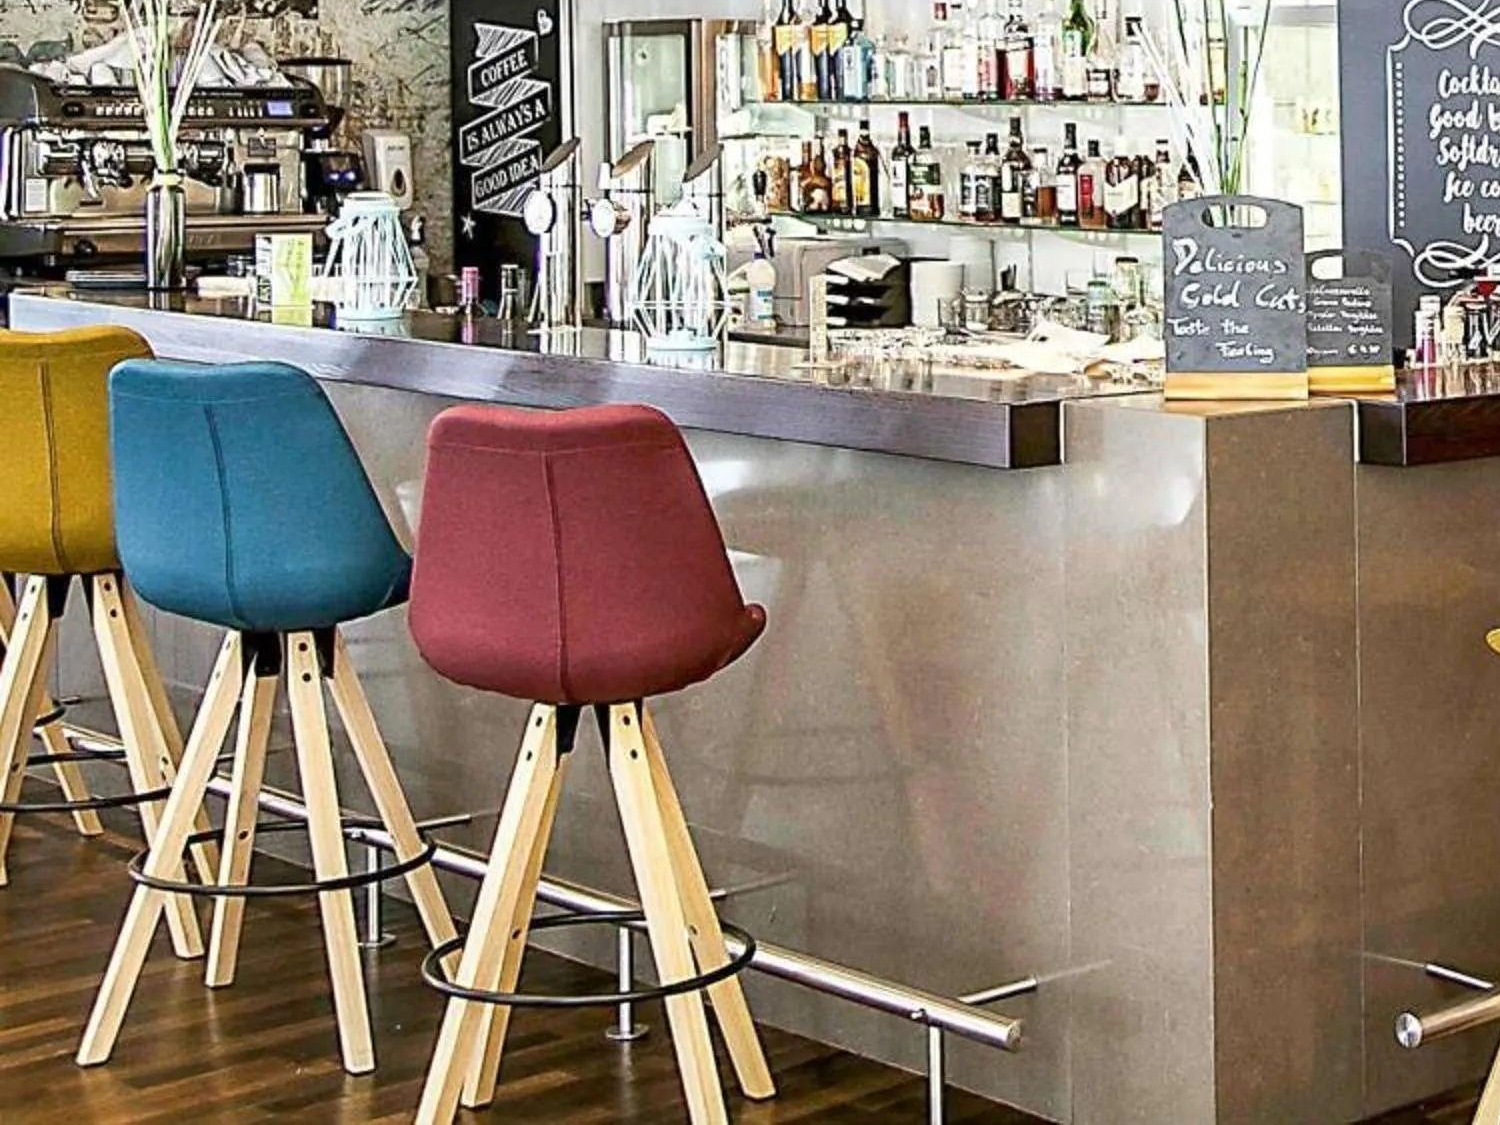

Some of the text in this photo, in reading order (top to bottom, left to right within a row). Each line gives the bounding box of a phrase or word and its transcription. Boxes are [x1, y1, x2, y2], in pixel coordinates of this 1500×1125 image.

[481, 48, 528, 87] COFFEE
[466, 98, 546, 152] IS ALWAYS A
[1429, 99, 1483, 140] Good
[474, 154, 540, 199] GOOD IDEA
[1171, 237, 1287, 275] Delicious
[1220, 318, 1250, 336] the
